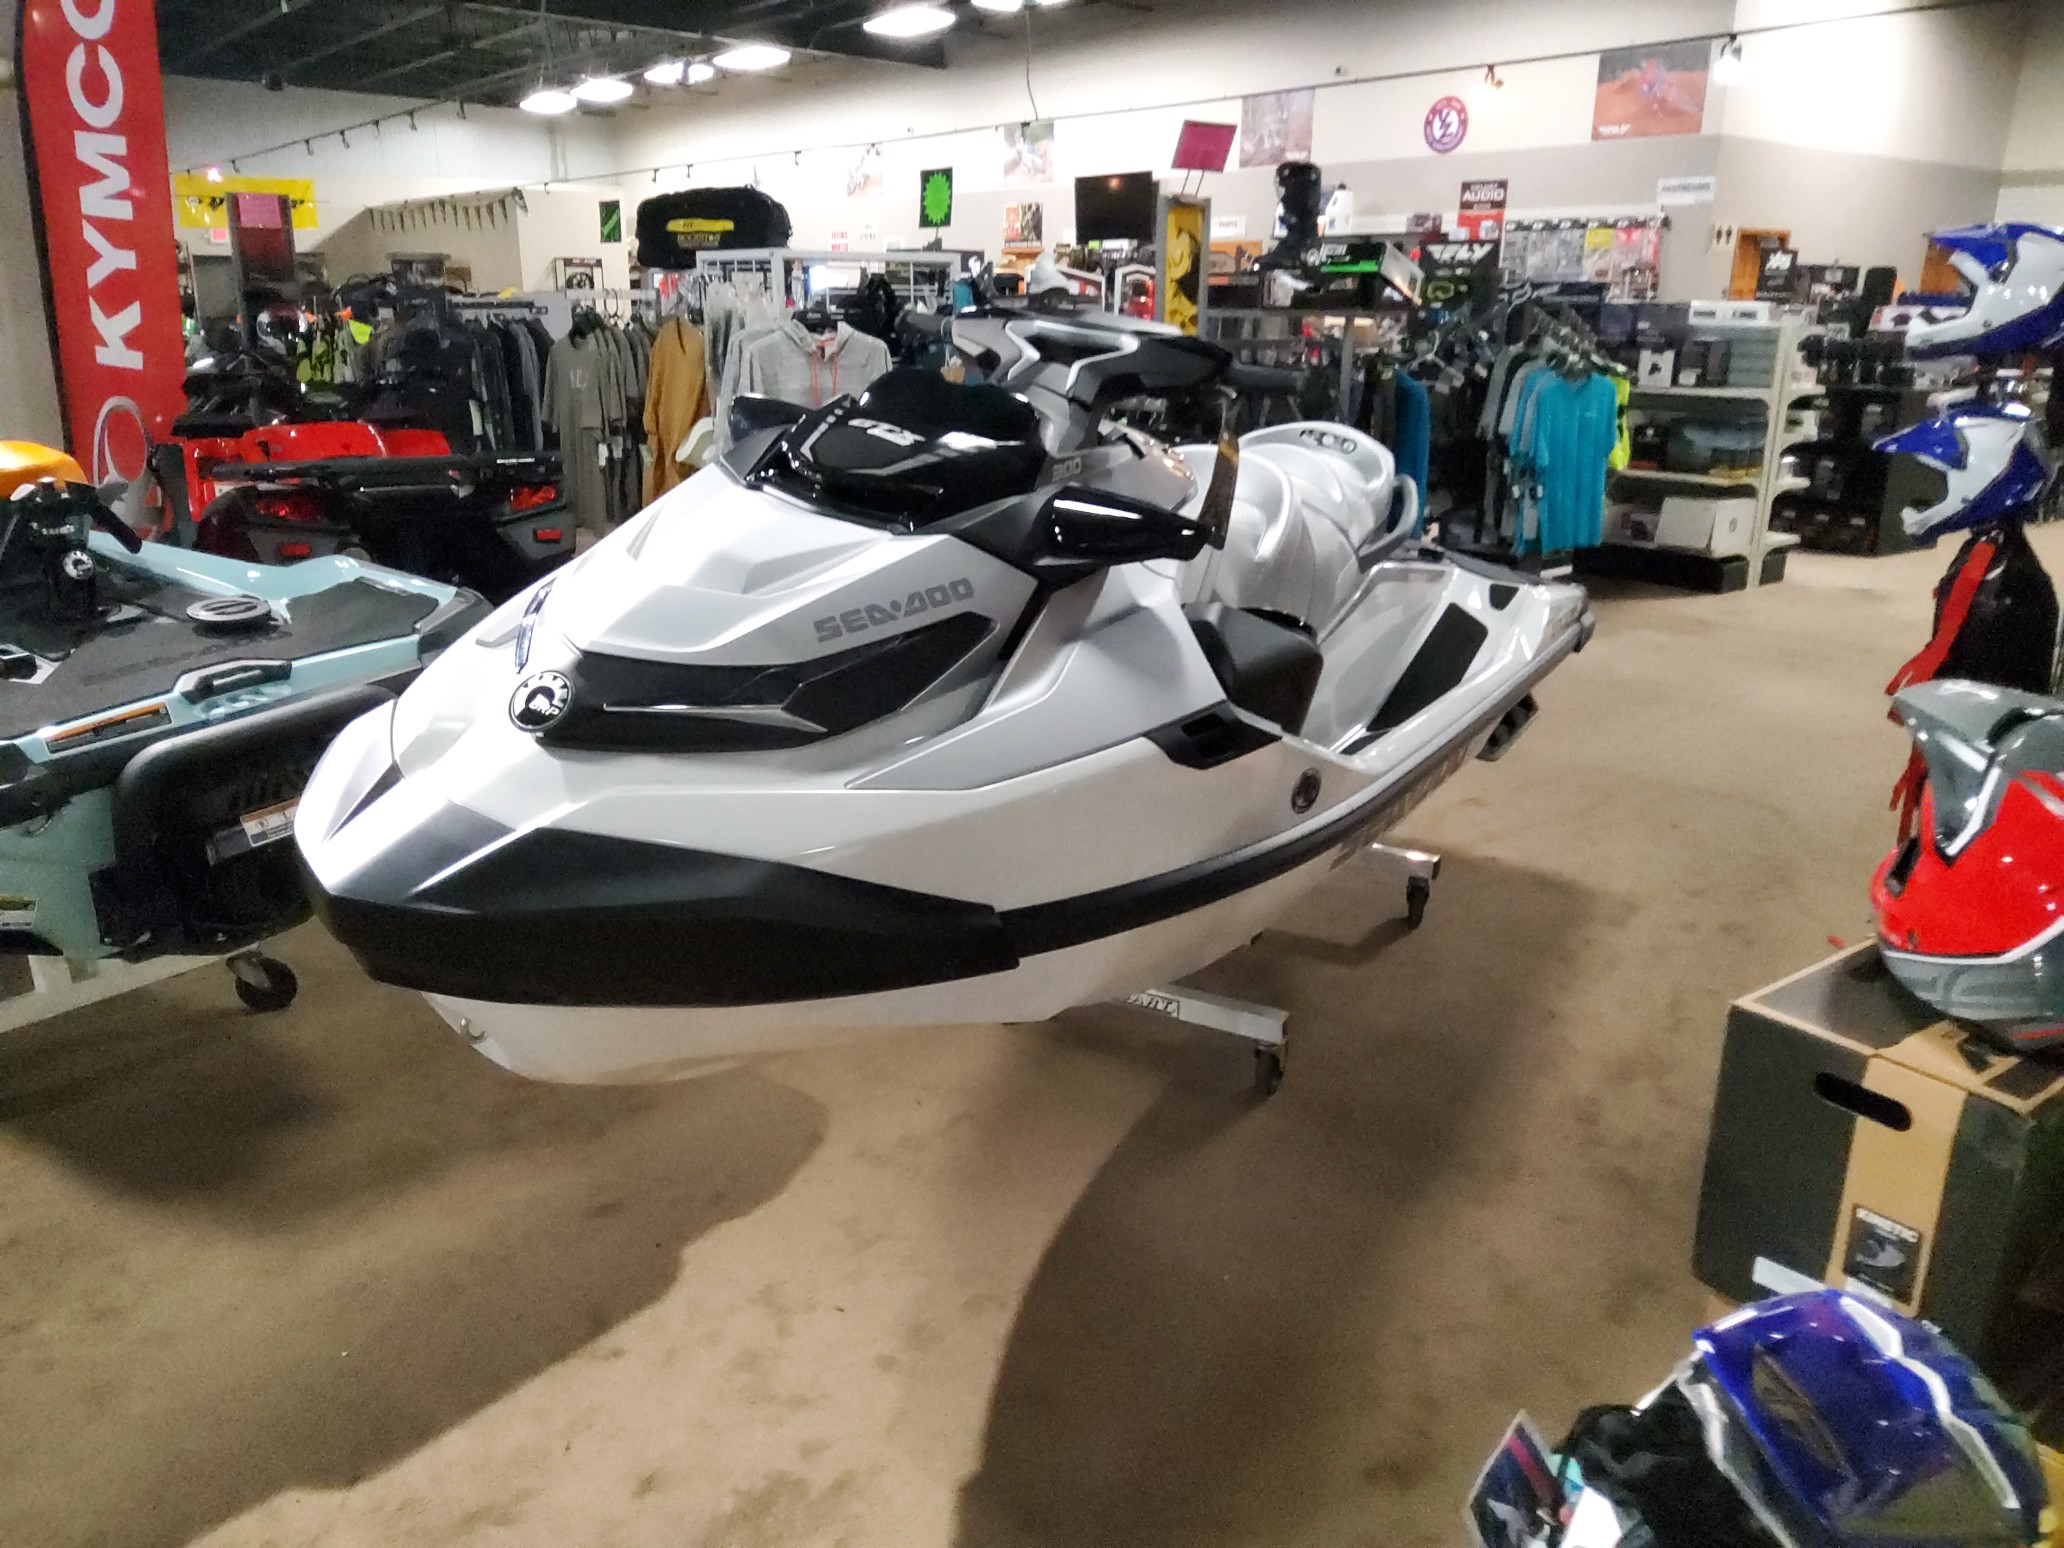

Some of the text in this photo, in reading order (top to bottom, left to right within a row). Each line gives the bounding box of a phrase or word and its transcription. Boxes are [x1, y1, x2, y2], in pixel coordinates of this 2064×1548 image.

[1462, 188, 1504, 202] AUDIO
[1426, 243, 1495, 265] FLY
[528, 693, 560, 716] BRP
